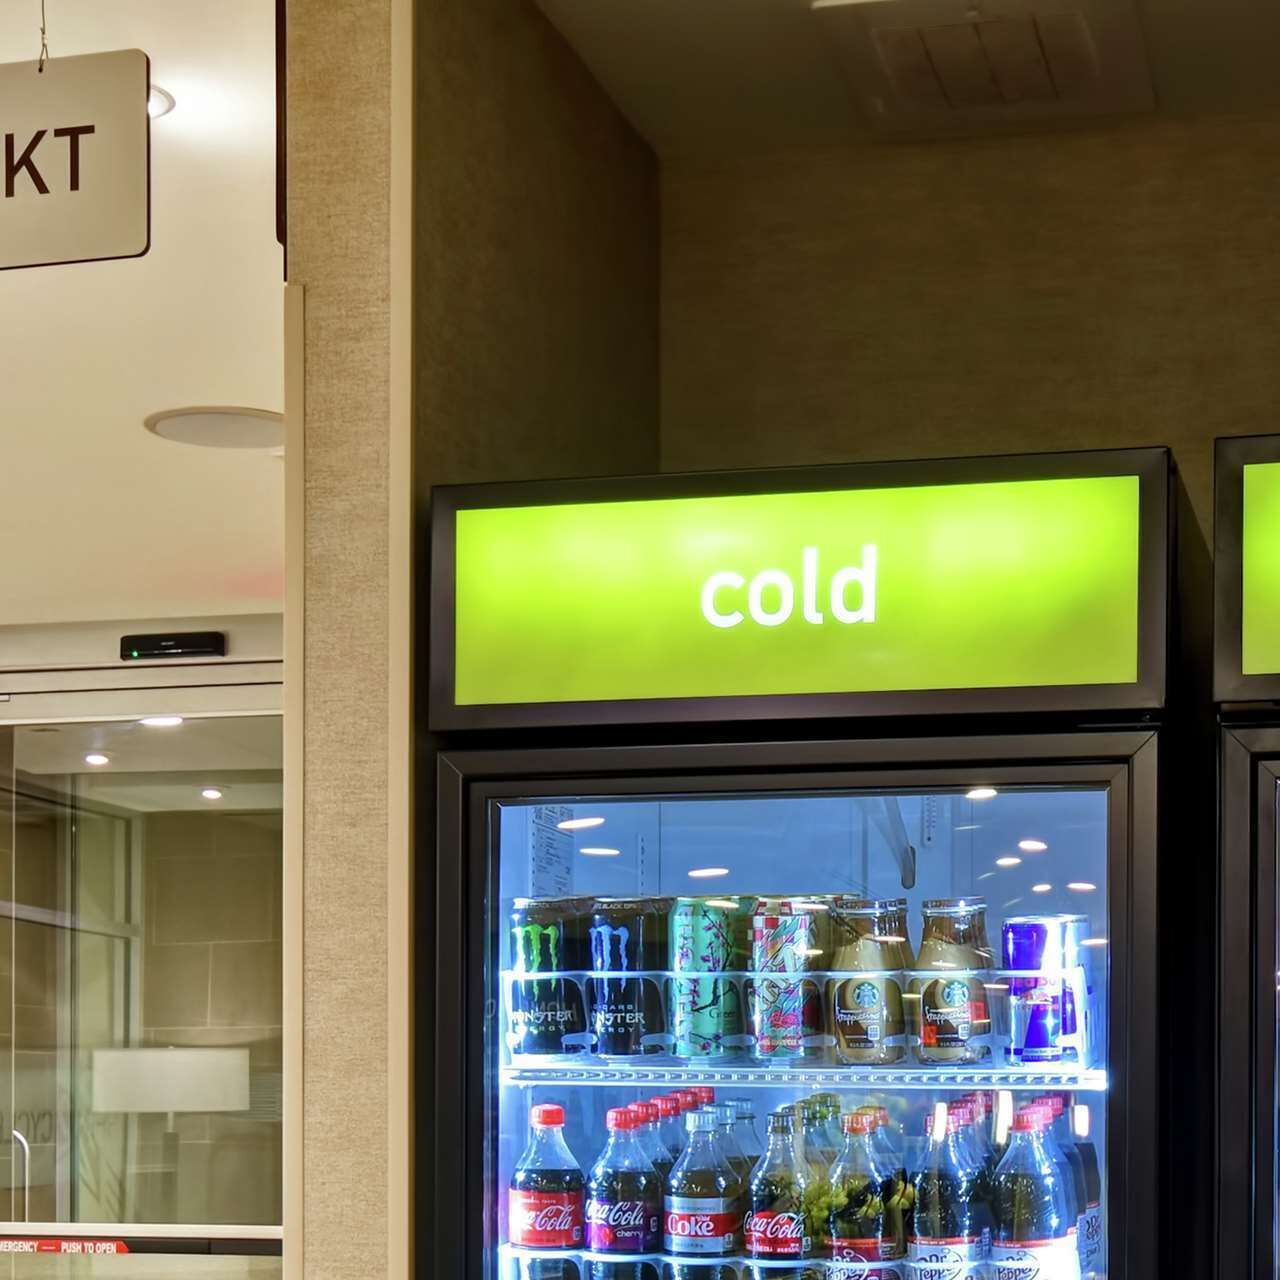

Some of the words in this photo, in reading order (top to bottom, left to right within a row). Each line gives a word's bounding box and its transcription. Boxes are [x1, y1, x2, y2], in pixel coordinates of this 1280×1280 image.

[701, 543, 878, 629] cold
[616, 1230, 643, 1238] cherry
[668, 1218, 714, 1236] Coke
[61, 1241, 82, 1252] PUSH
[84, 1241, 94, 1253] TO
[96, 1242, 116, 1253] OPEN
